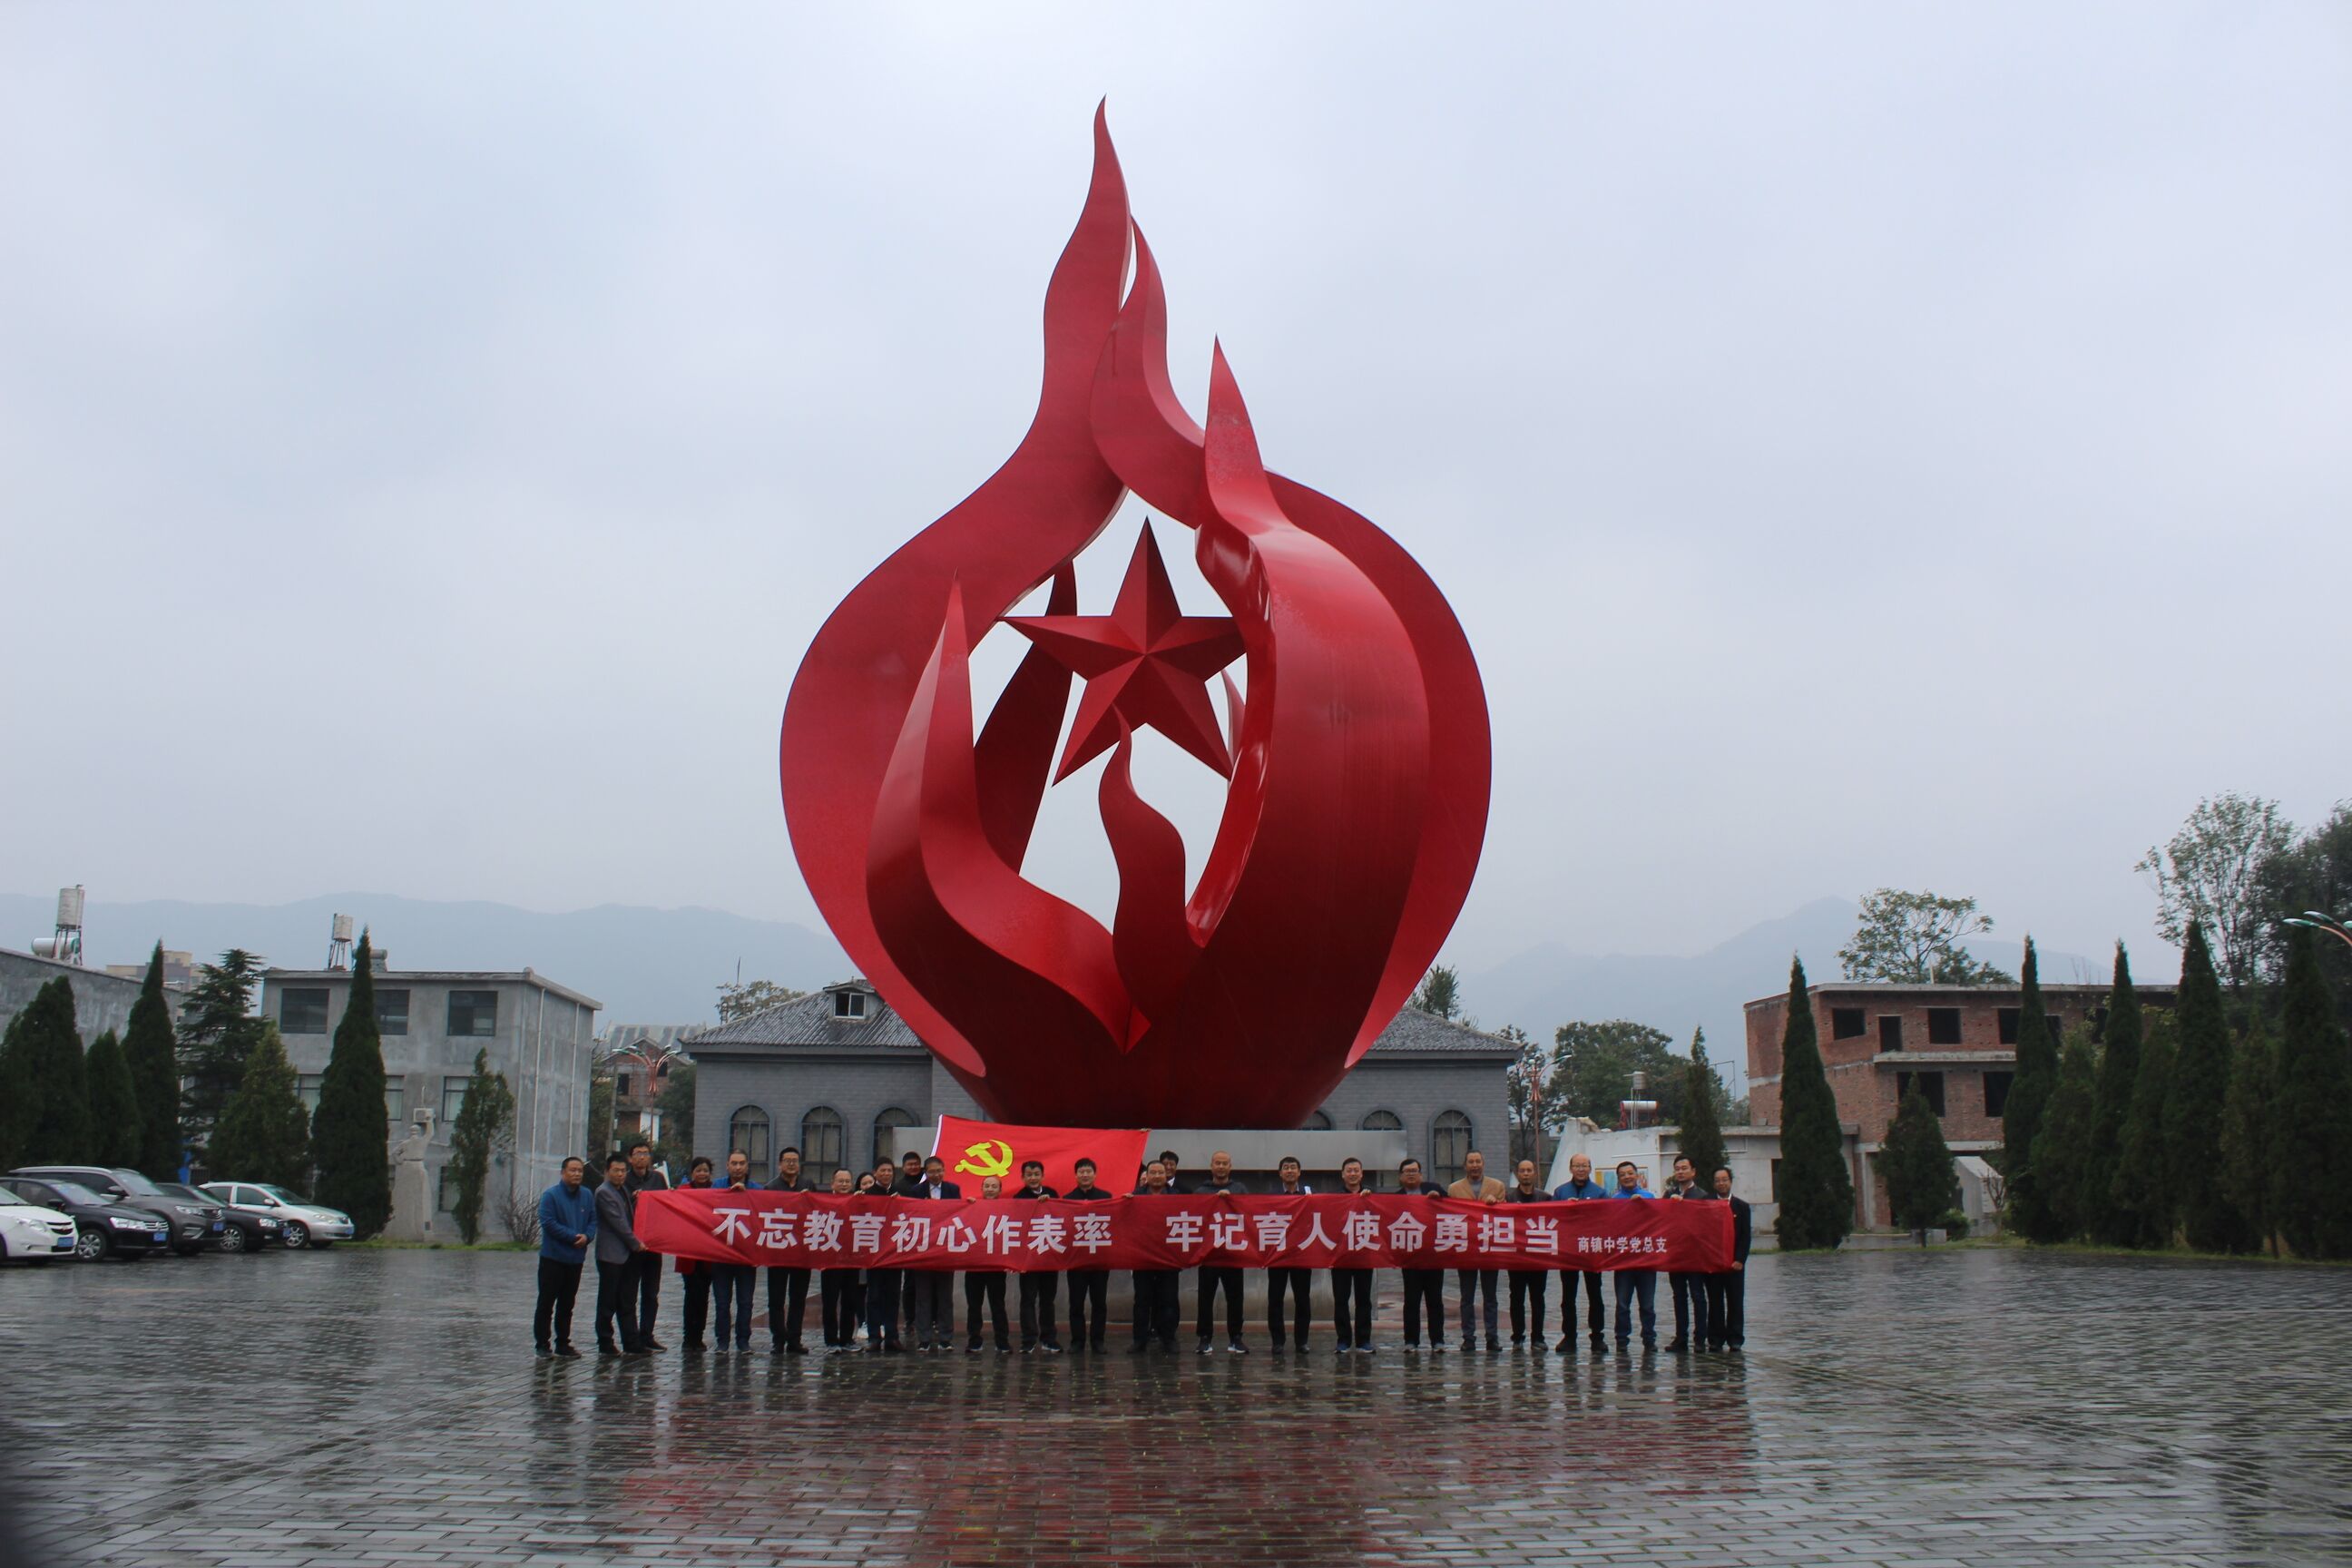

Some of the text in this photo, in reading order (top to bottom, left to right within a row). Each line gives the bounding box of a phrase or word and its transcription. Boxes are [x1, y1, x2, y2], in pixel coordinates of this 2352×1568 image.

[712, 1208, 1558, 1255] 不忘教育初心作表率 牢记育人使命勇担当
[1577, 1237, 1667, 1253] 商镇中学党总支
